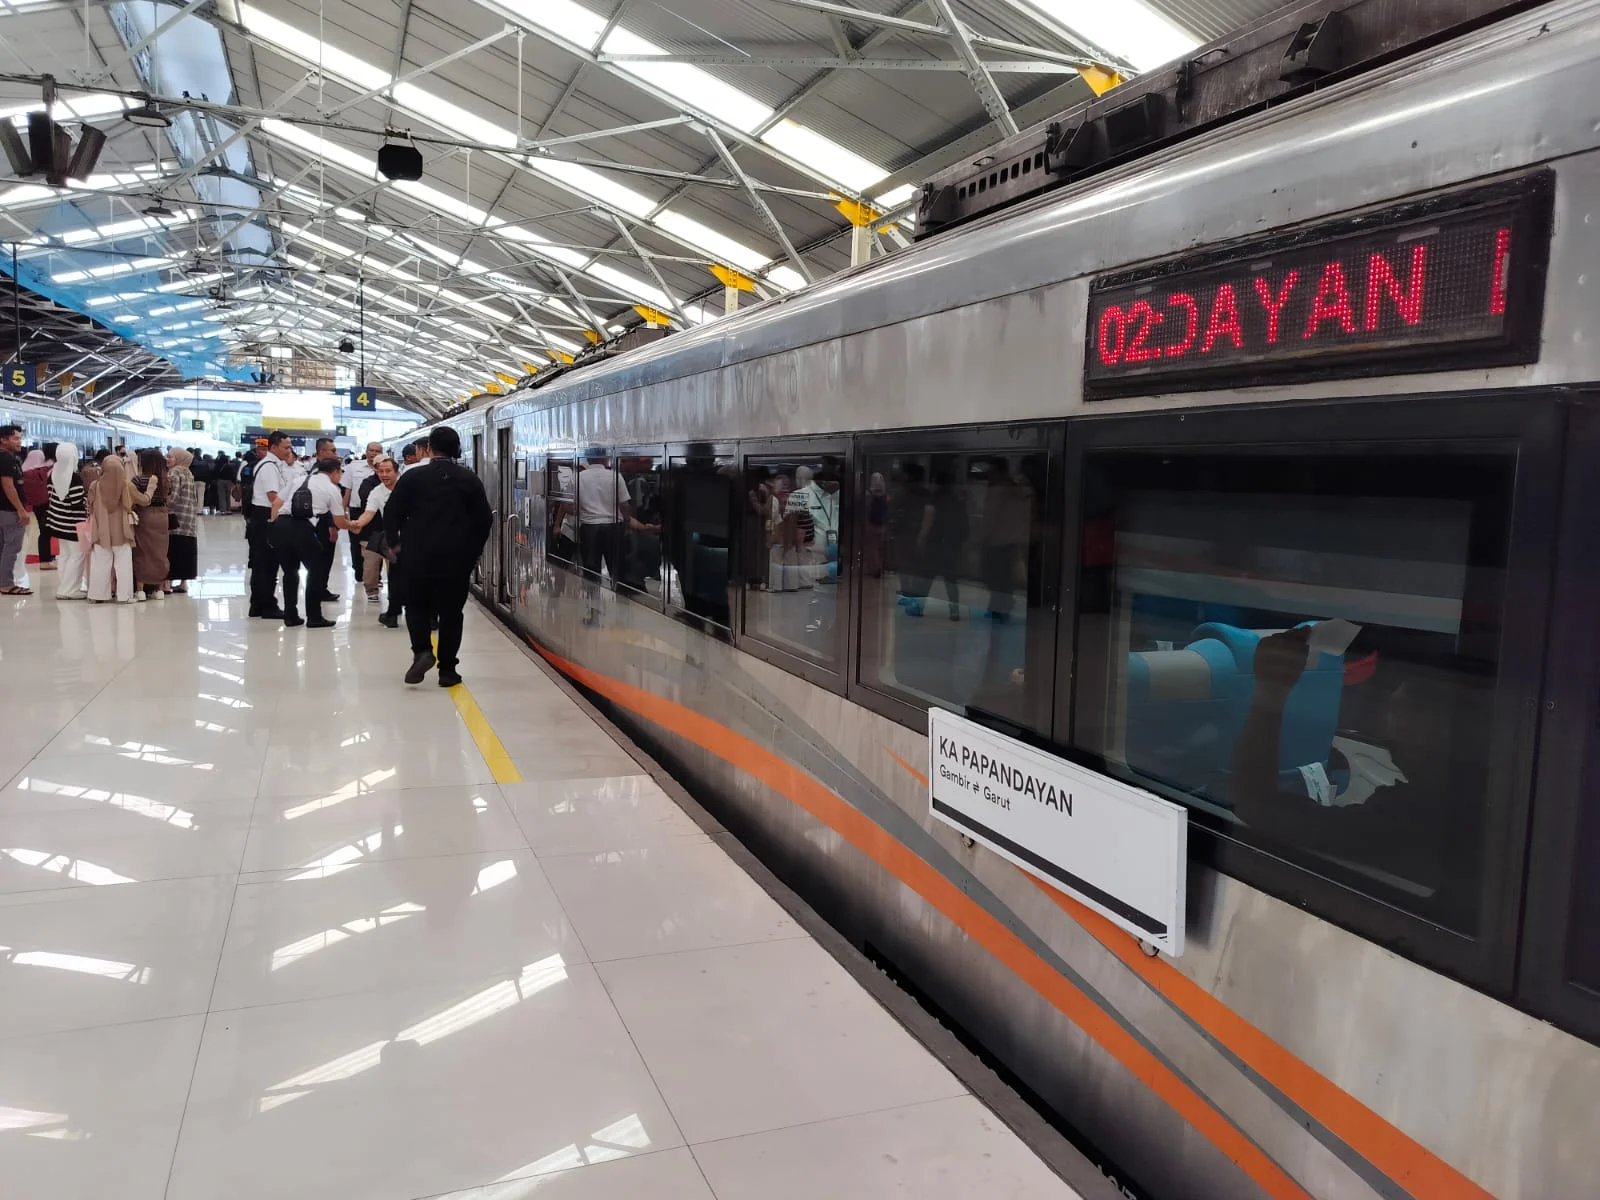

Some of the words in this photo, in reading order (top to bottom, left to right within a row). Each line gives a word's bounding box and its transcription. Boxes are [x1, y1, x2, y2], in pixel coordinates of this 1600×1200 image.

[12, 369, 26, 387] 5
[356, 391, 370, 407] 4
[939, 735, 959, 763] KA
[962, 745, 1073, 817] PAPANDAYAN
[939, 764, 970, 790] Gambir
[983, 786, 1011, 811] Garut
